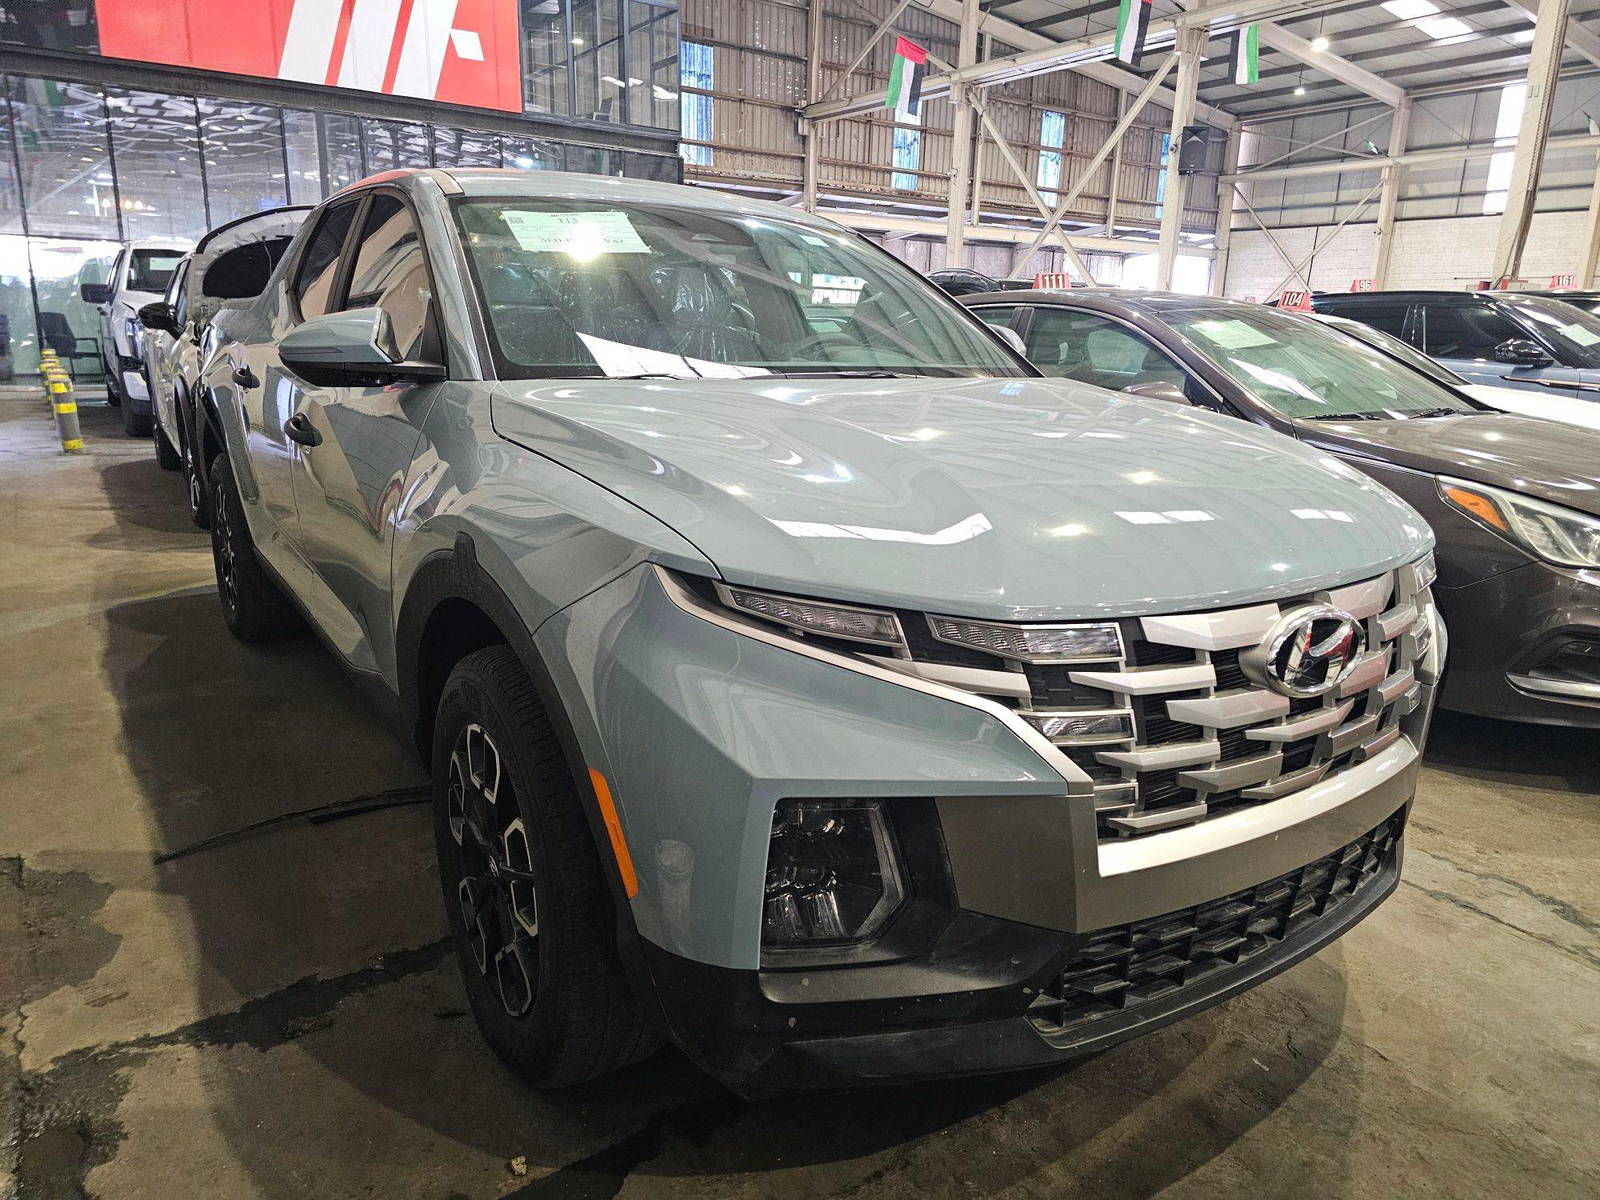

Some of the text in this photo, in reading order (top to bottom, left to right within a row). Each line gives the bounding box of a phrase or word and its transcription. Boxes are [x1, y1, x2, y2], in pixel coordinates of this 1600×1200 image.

[1044, 274, 1064, 288] 111
[1360, 280, 1371, 291] 96
[1559, 275, 1574, 286] 161
[1284, 292, 1304, 307] 104
